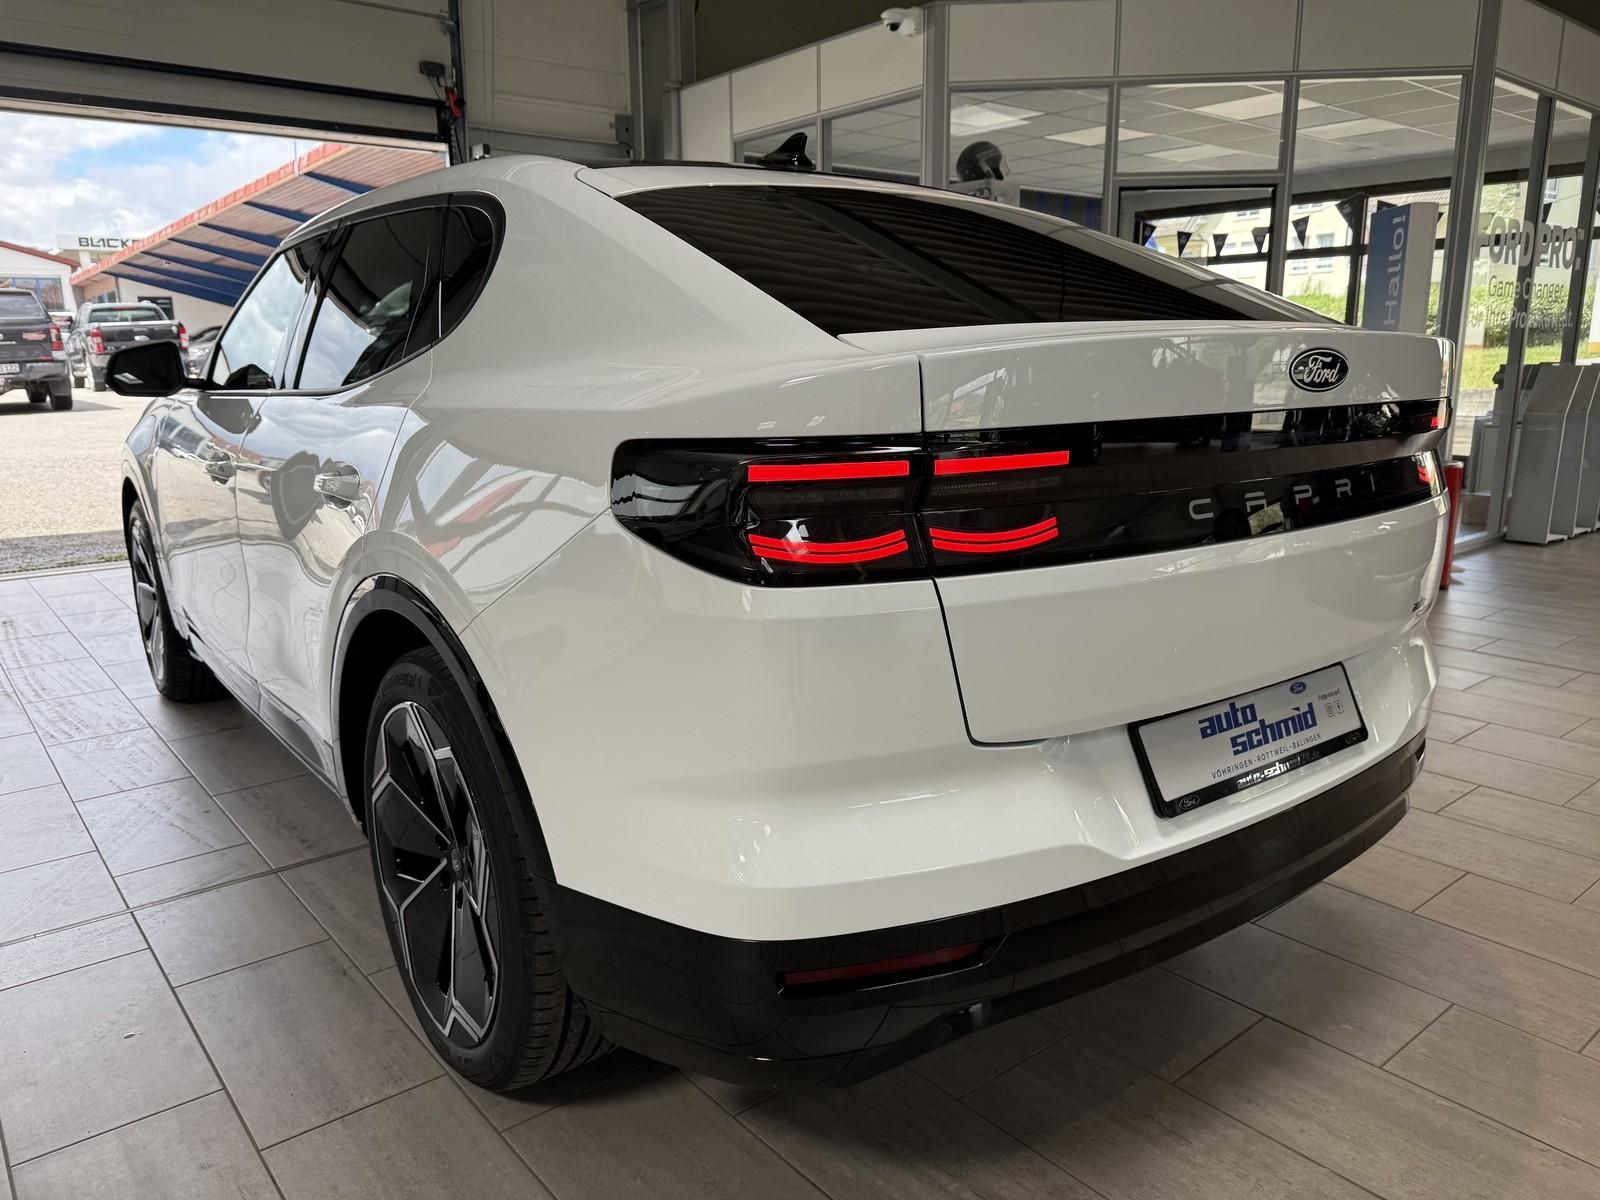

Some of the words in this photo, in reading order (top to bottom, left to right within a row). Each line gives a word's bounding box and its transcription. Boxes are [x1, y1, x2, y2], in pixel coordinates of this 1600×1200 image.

[78, 237, 139, 248] BLACK
[1383, 215, 1406, 326] Hallo!
[1488, 275, 1520, 298] Game
[1303, 355, 1341, 383] Ford
[1188, 473, 1376, 520] CAPRI
[1198, 701, 1258, 739] auto
[1230, 702, 1318, 756] schmid
